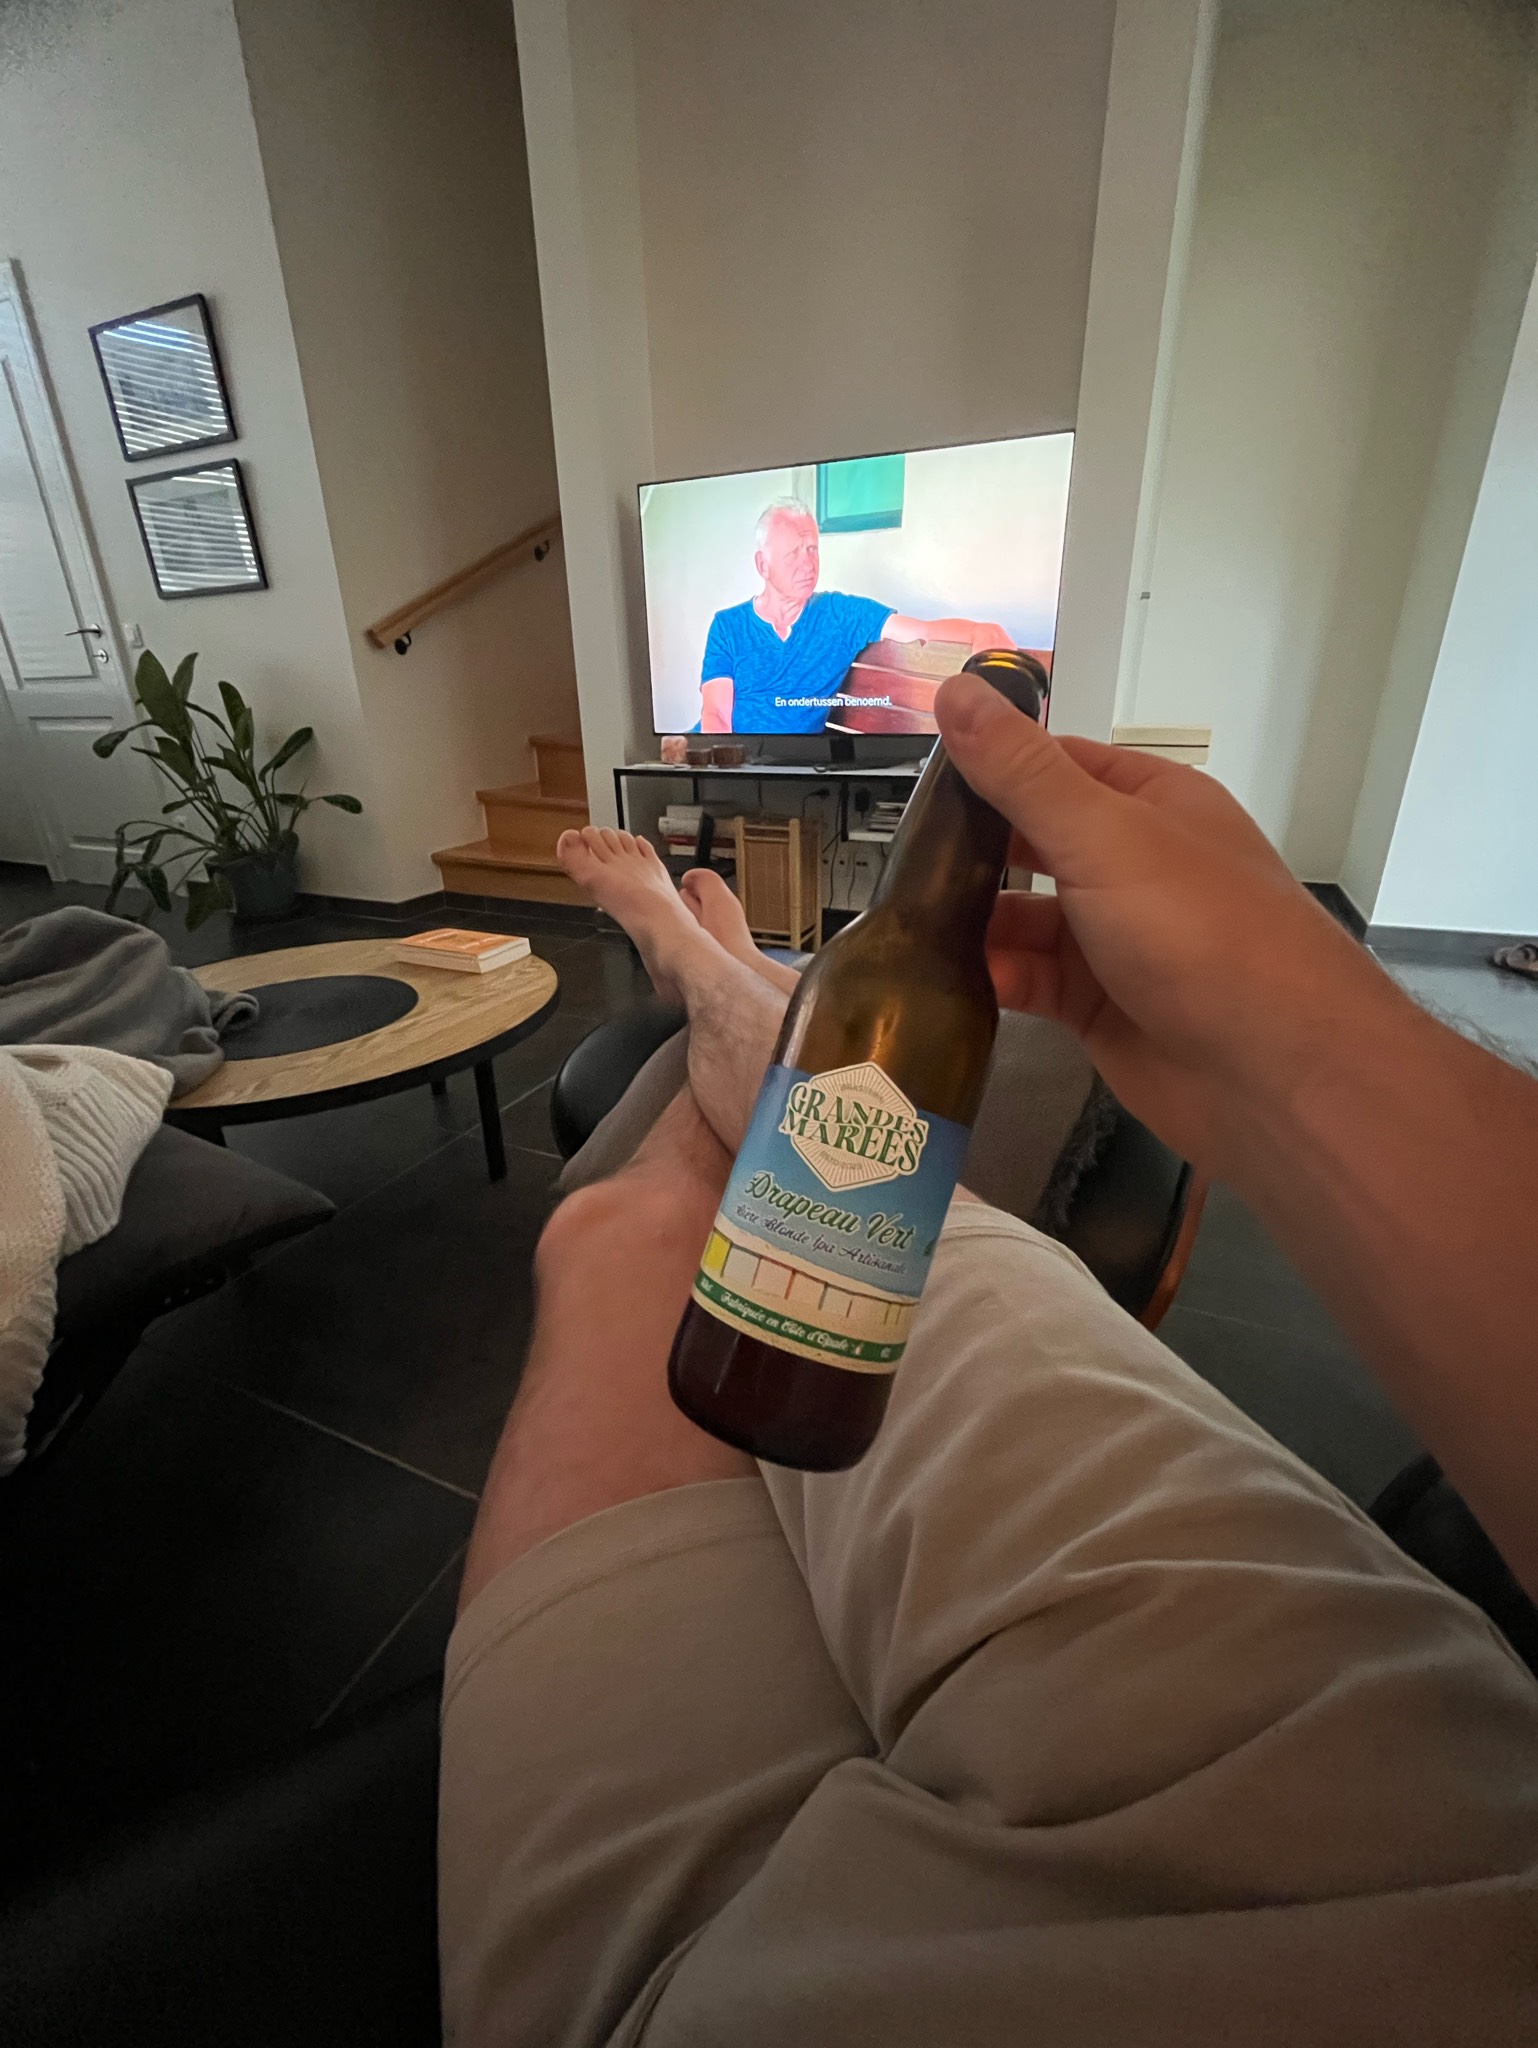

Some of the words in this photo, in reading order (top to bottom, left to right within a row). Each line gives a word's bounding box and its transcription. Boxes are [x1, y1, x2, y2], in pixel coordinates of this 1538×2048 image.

[775, 697, 786, 706] En
[788, 697, 844, 706] ondertussen
[845, 696, 892, 706] benoemd.
[790, 1084, 926, 1144] GRANDES
[744, 1171, 860, 1234] Drapeau
[867, 1212, 916, 1250] Vert
[760, 1215, 810, 1245] Blonde
[766, 1317, 780, 1328] en
